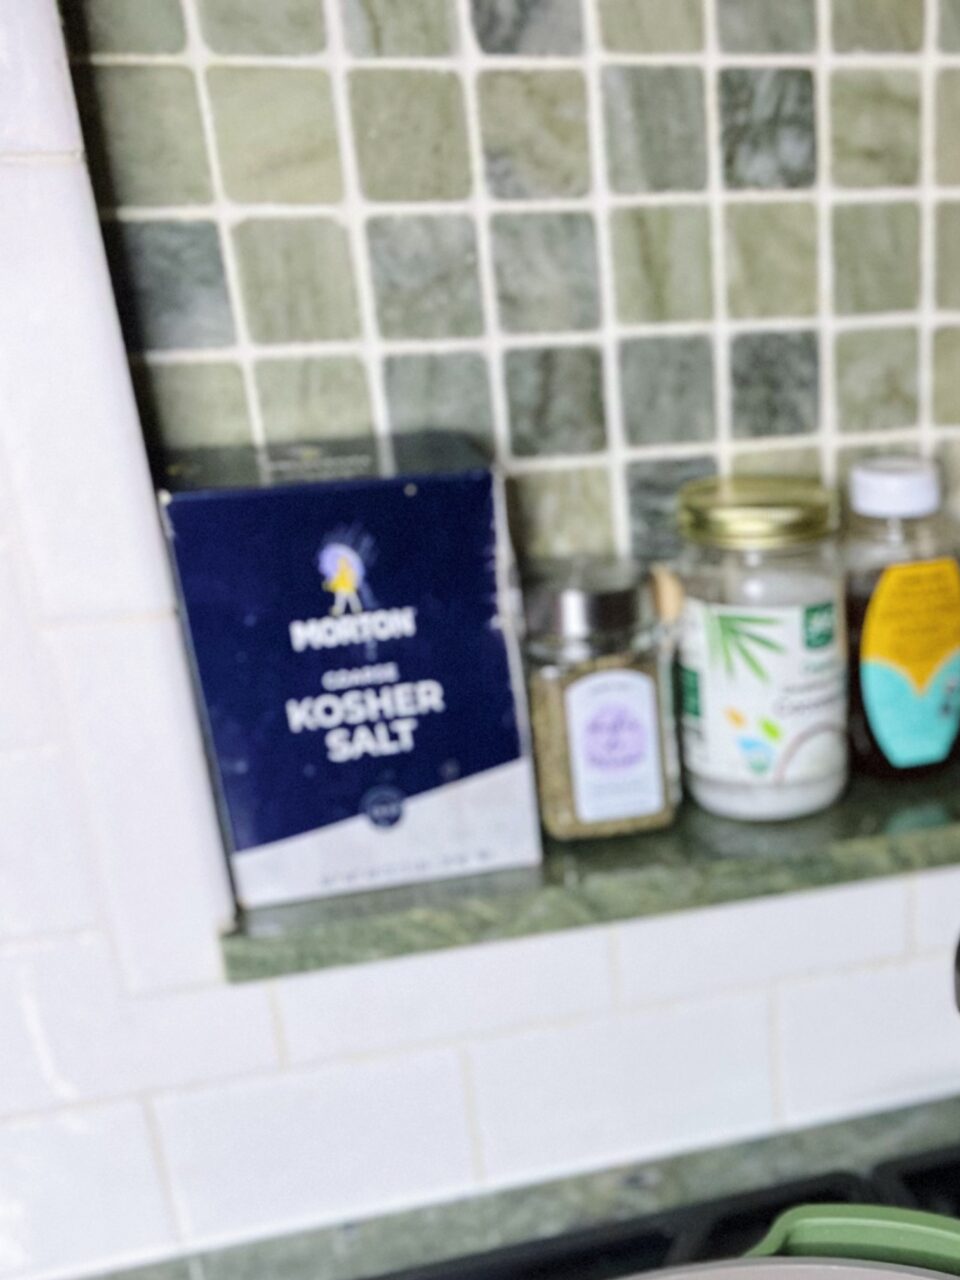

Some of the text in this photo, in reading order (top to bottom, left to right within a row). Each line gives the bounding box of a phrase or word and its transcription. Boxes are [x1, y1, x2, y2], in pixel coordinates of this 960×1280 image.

[290, 606, 417, 652] MORTON
[286, 680, 445, 733] KOSHER
[325, 718, 418, 763] SALT
